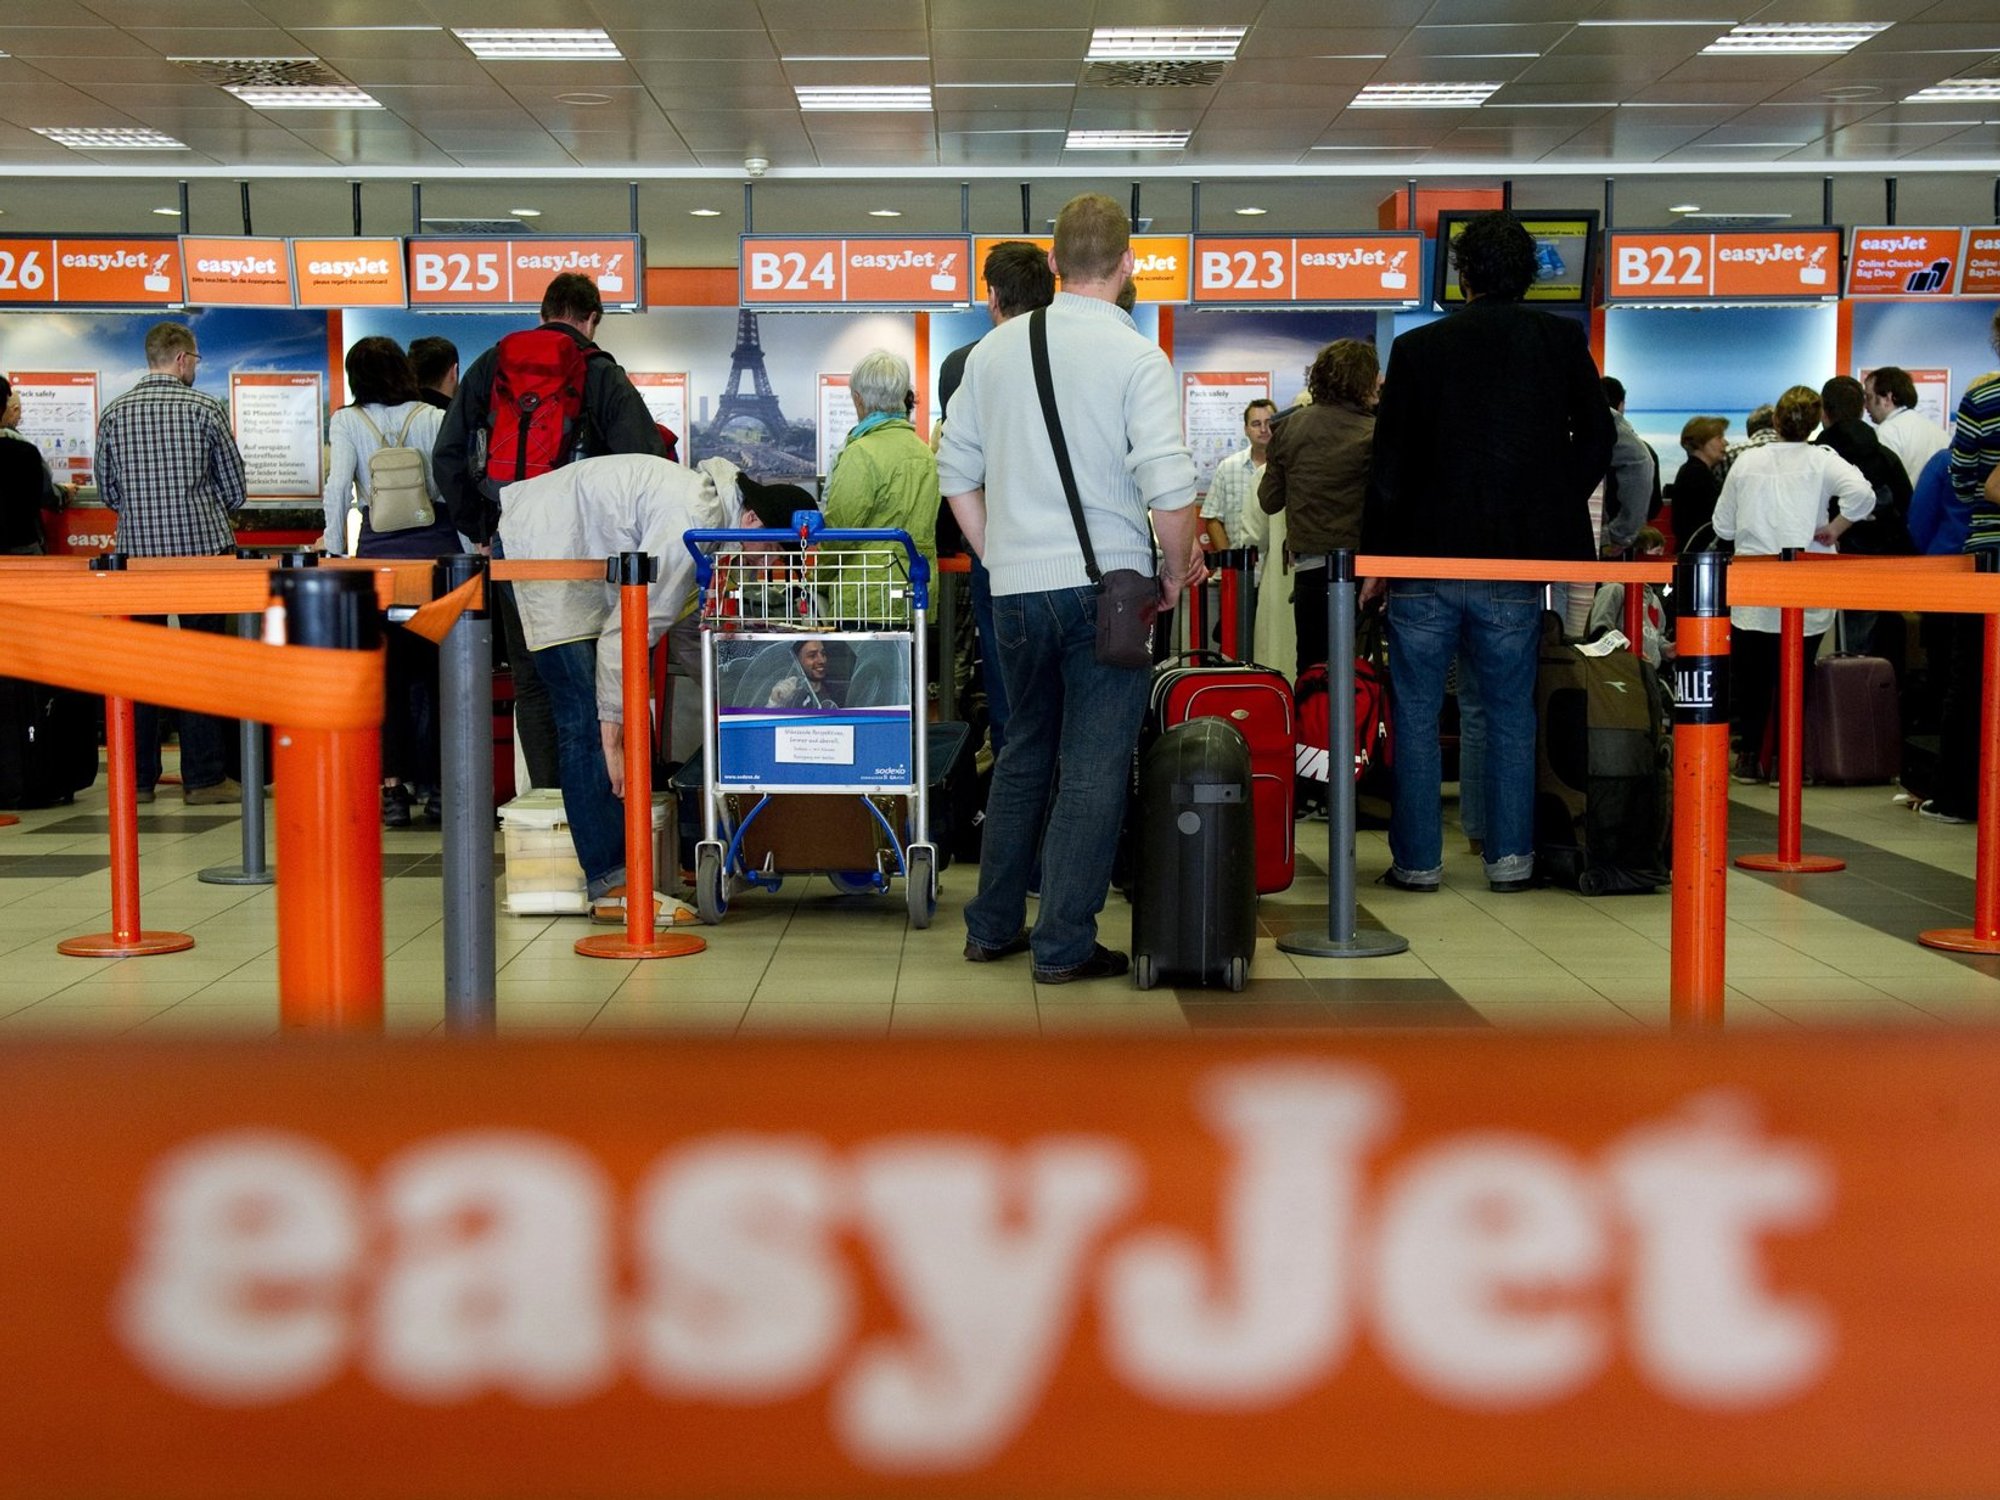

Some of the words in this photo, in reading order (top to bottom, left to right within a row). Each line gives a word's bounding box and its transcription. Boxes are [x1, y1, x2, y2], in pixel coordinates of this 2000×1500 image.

[1719, 243, 1805, 264] easyJet
[1861, 236, 1928, 253] easyJet
[62, 249, 148, 272] easyJet
[197, 256, 277, 277] easyJet
[308, 257, 389, 278] easyJet
[516, 251, 601, 272] easyJet
[851, 250, 935, 271] easyJet
[1300, 249, 1386, 270] easyJet
[1618, 247, 1703, 285] B22
[1857, 260, 1886, 268] Online
[0, 251, 44, 290] 26
[415, 253, 499, 292] B25
[751, 252, 836, 290] B24
[1202, 251, 1284, 290] B23
[1856, 269, 1873, 279] Bag
[1874, 269, 1896, 279] Drop
[1674, 671, 1713, 702] ALLE
[875, 765, 906, 774] sodexo
[122, 1063, 1836, 1467] easyJet
